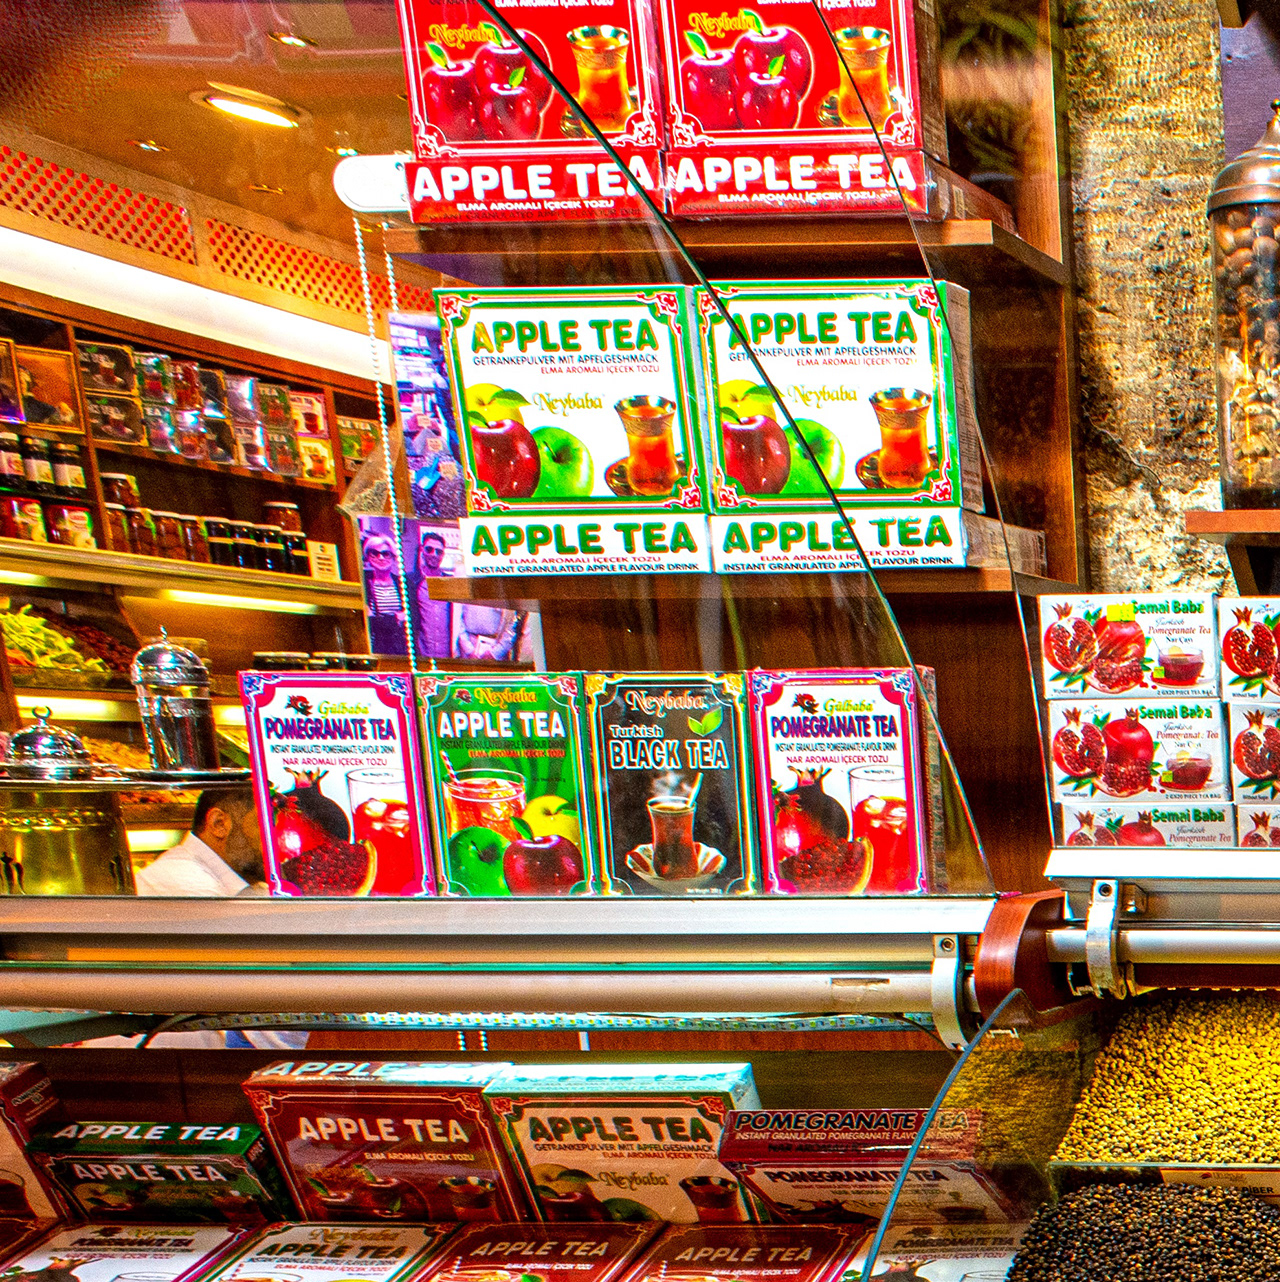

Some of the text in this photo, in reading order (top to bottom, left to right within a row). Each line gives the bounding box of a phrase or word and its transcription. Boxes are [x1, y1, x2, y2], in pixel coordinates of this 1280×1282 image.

[675, 152, 915, 192] APPLE TEA
[414, 162, 653, 202] APPLE TEA
[456, 202, 490, 212] ELMA
[491, 201, 538, 211] AROMALI
[584, 199, 613, 209] TOZU
[815, 347, 831, 357] MIT
[788, 384, 858, 407] Neybaba
[534, 392, 603, 415] Neybaba
[473, 563, 699, 575] INSTANT GRANULATED APPLE FLAVOUR DRINK
[872, 556, 953, 567] FLAVOUR DRINK
[612, 725, 663, 737] Turkish
[772, 716, 899, 737] POMEGRANATE TEA
[282, 757, 301, 767] NAR
[302, 757, 336, 766] AROMALI
[365, 757, 388, 767] TOZU
[611, 740, 729, 769] BLACK TEA
[1152, 810, 1224, 823] Semai Baba
[54, 1124, 241, 1142] APPLE TEA
[734, 1131, 888, 1141] INSTANT GRANULATED POMEGRANATE
[599, 1170, 667, 1189] Neybaba
